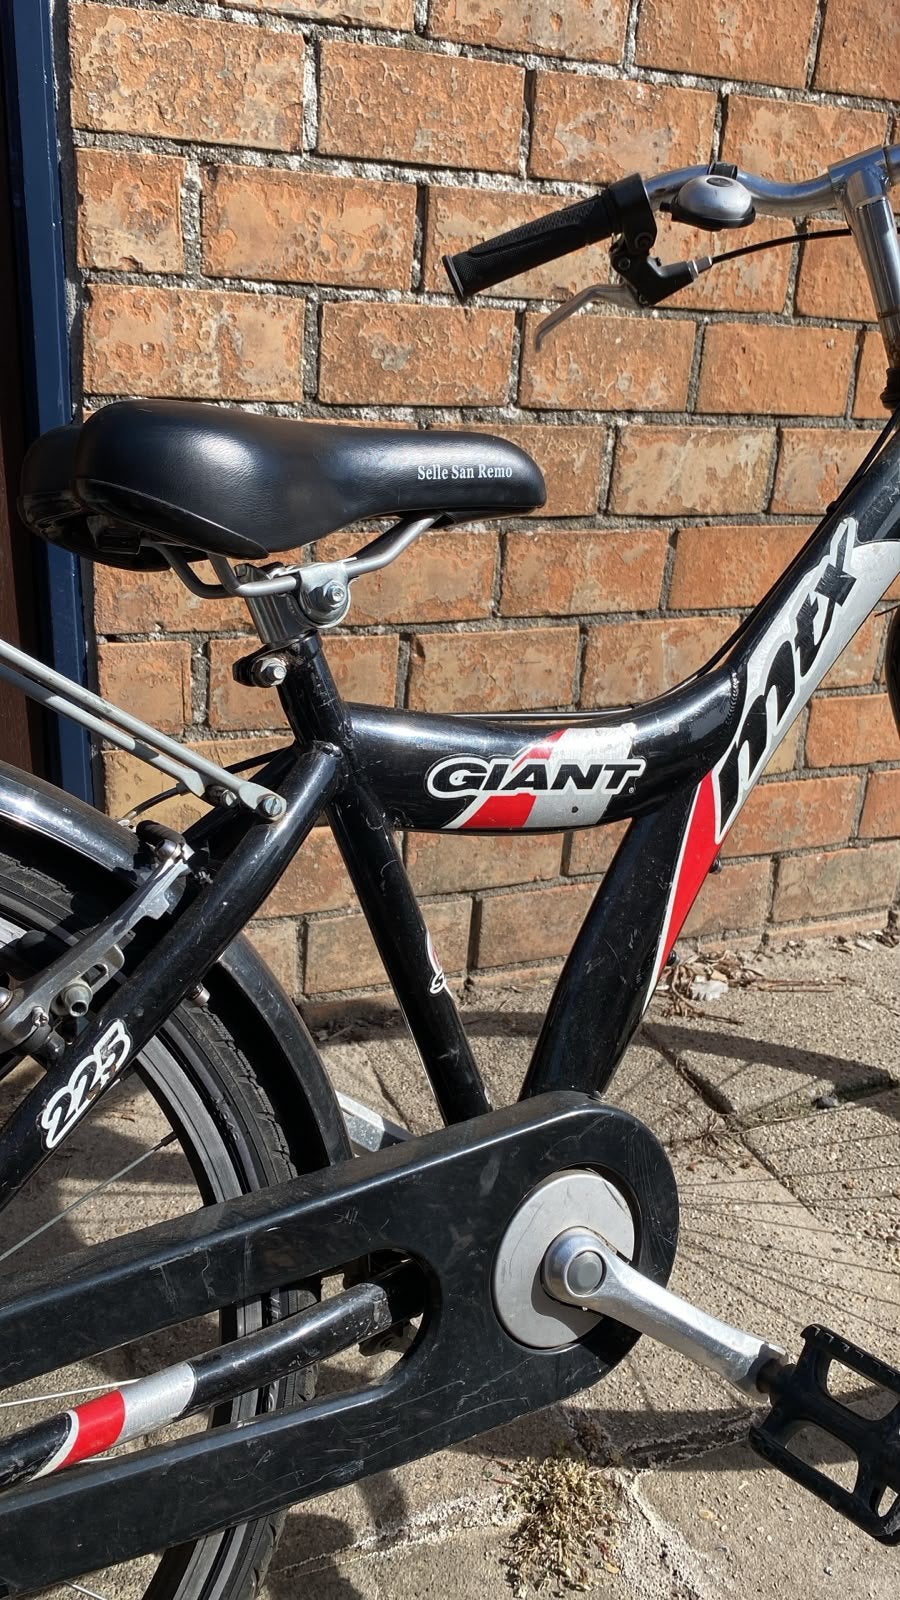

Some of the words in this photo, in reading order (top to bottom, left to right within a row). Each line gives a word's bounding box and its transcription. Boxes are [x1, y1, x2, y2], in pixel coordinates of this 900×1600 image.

[417, 463, 448, 480] Selle
[451, 463, 474, 479] San
[478, 463, 513, 479] Remo
[430, 760, 643, 795] GIANT
[42, 1021, 130, 1148] 225
